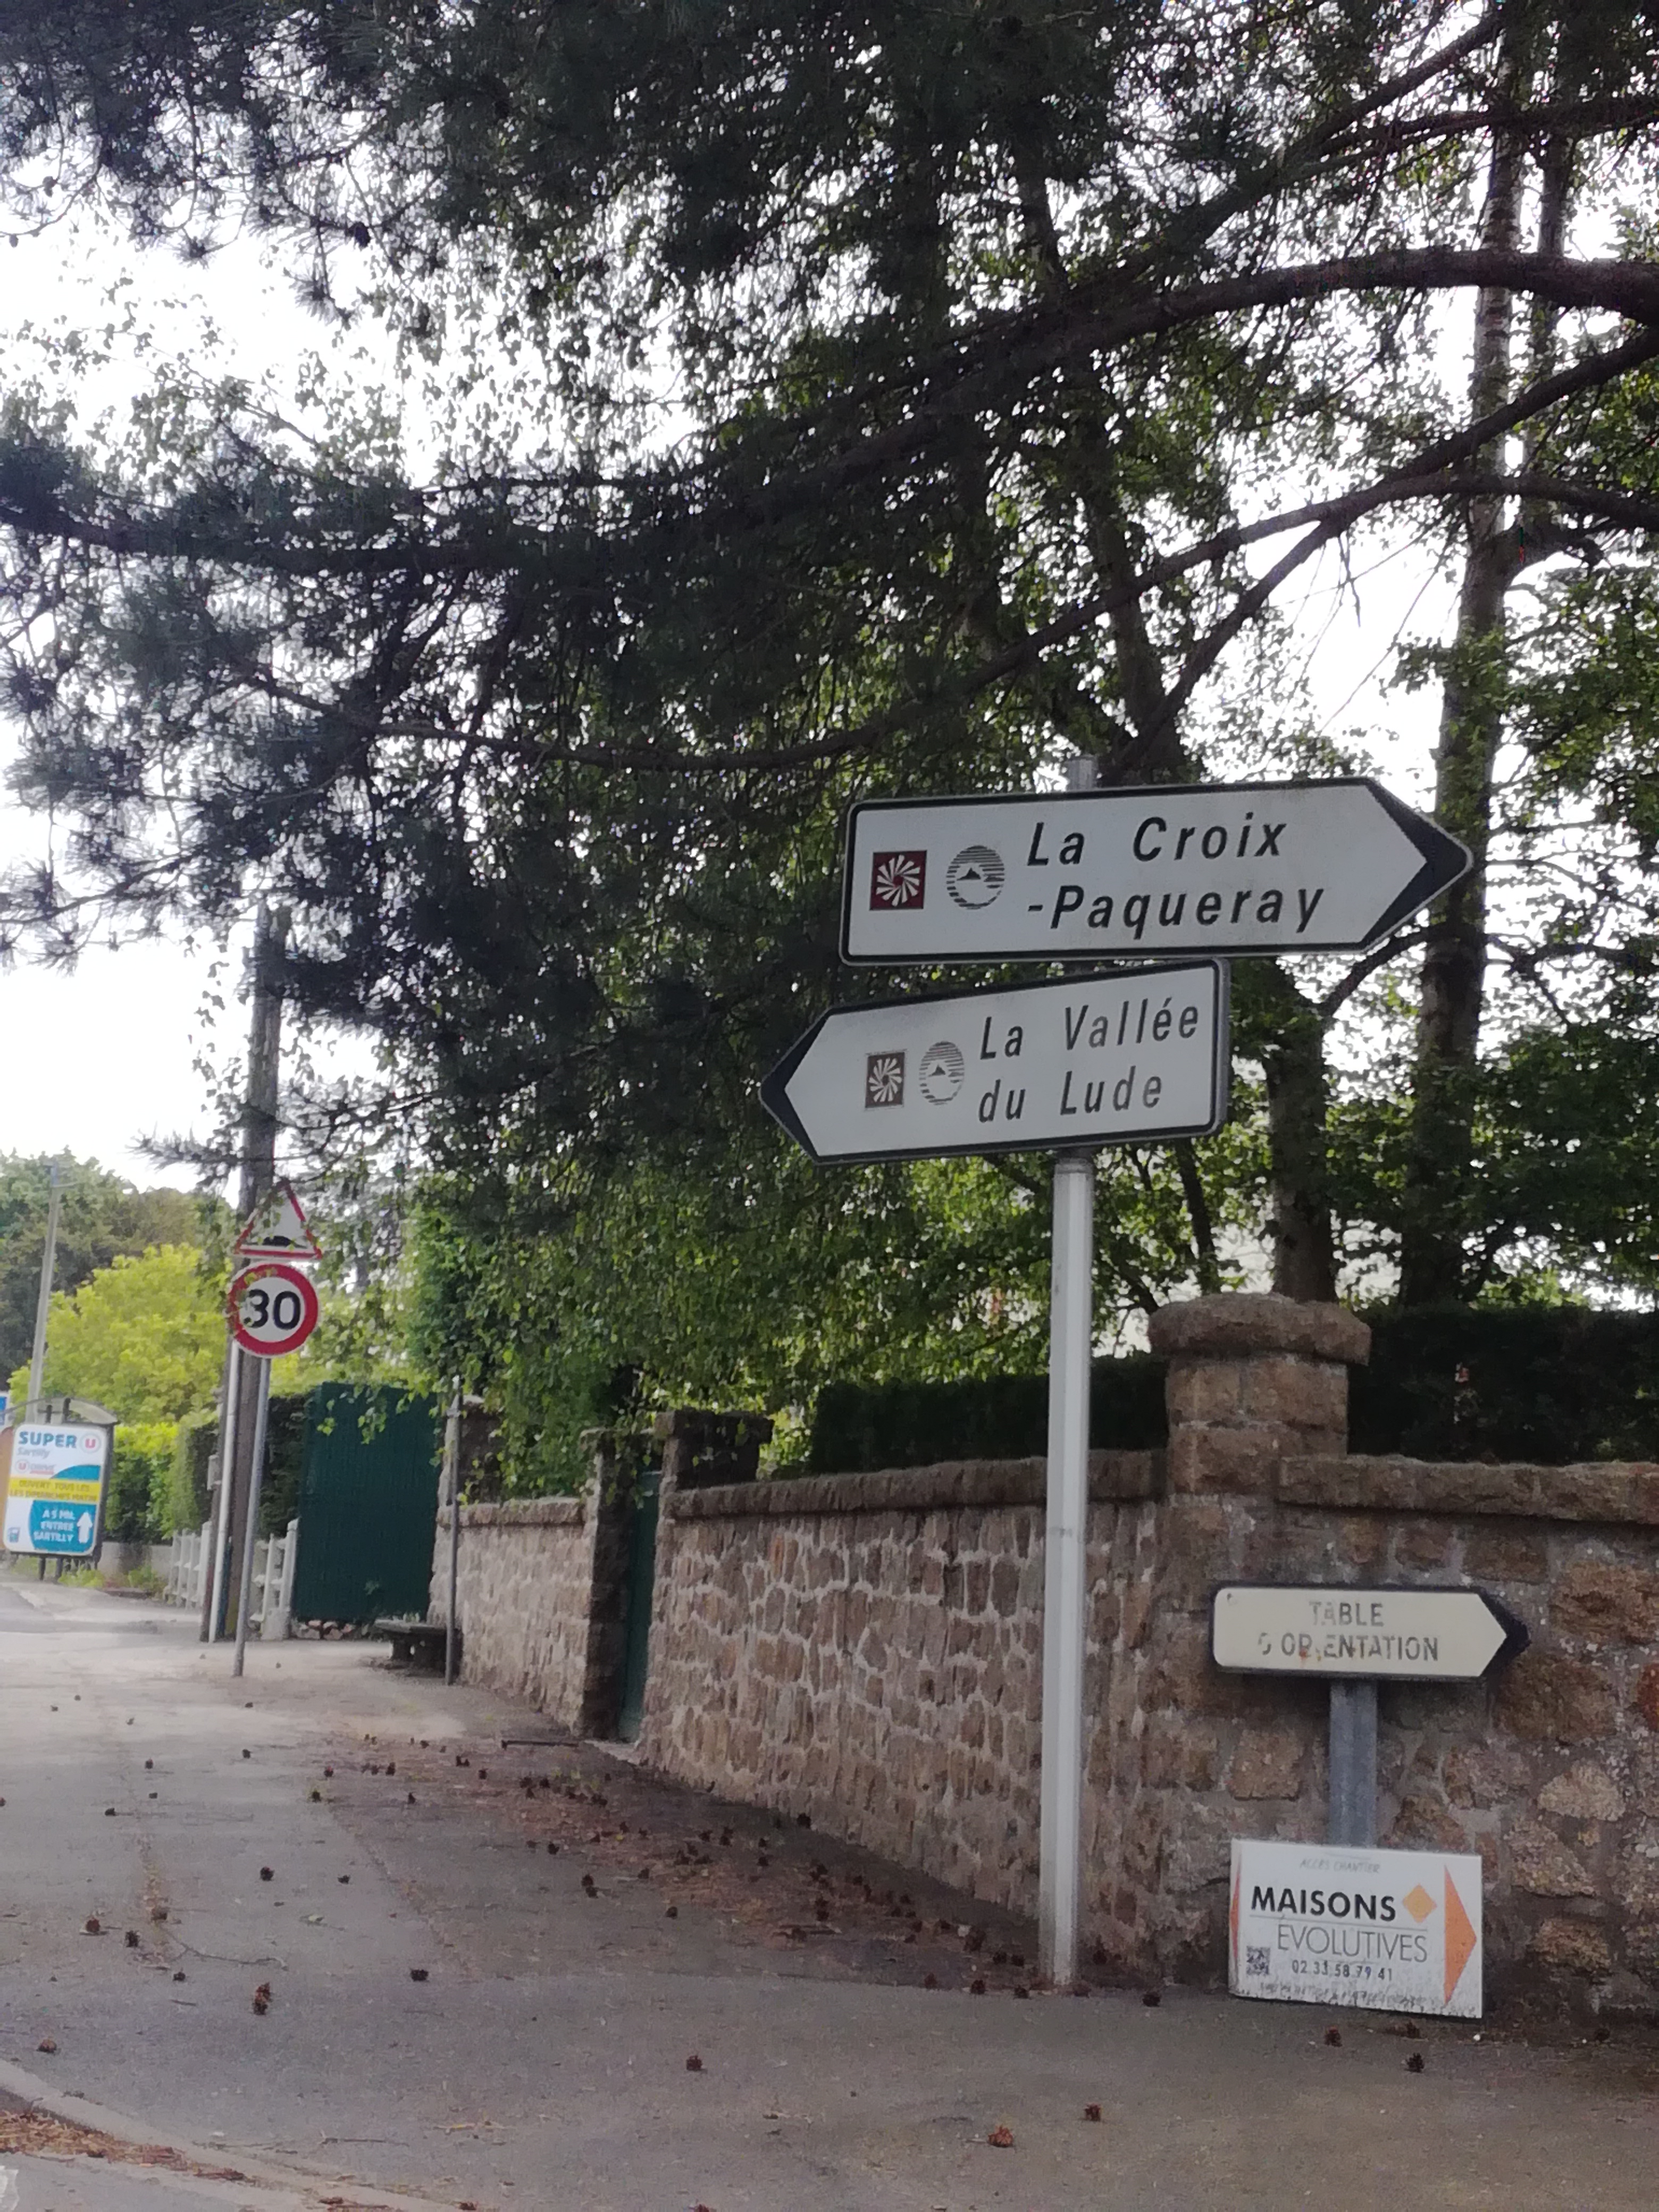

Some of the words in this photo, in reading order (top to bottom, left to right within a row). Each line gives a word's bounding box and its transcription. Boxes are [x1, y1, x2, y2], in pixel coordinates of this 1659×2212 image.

[1027, 822, 1085, 866] La
[1133, 811, 1287, 862] Croix
[1027, 885, 1324, 939] -Paqueray
[980, 1016, 1024, 1060] La
[1065, 996, 1199, 1051] Vallée
[978, 1078, 1025, 1122] du
[1060, 1065, 1162, 1116] Lude
[242, 1288, 301, 1330] 30
[19, 1431, 78, 1448] SUPER
[85, 1438, 96, 1449] U
[1309, 1601, 1385, 1627] TABLE
[1251, 1885, 1396, 1922] MAISONS
[1277, 1914, 1428, 1963] ÉVOLUTIVES
[1292, 1959, 1308, 1974] 02
[1313, 1960, 1328, 1976] 33
[1334, 1963, 1350, 1978] 58
[1378, 1967, 1393, 1981] 41
